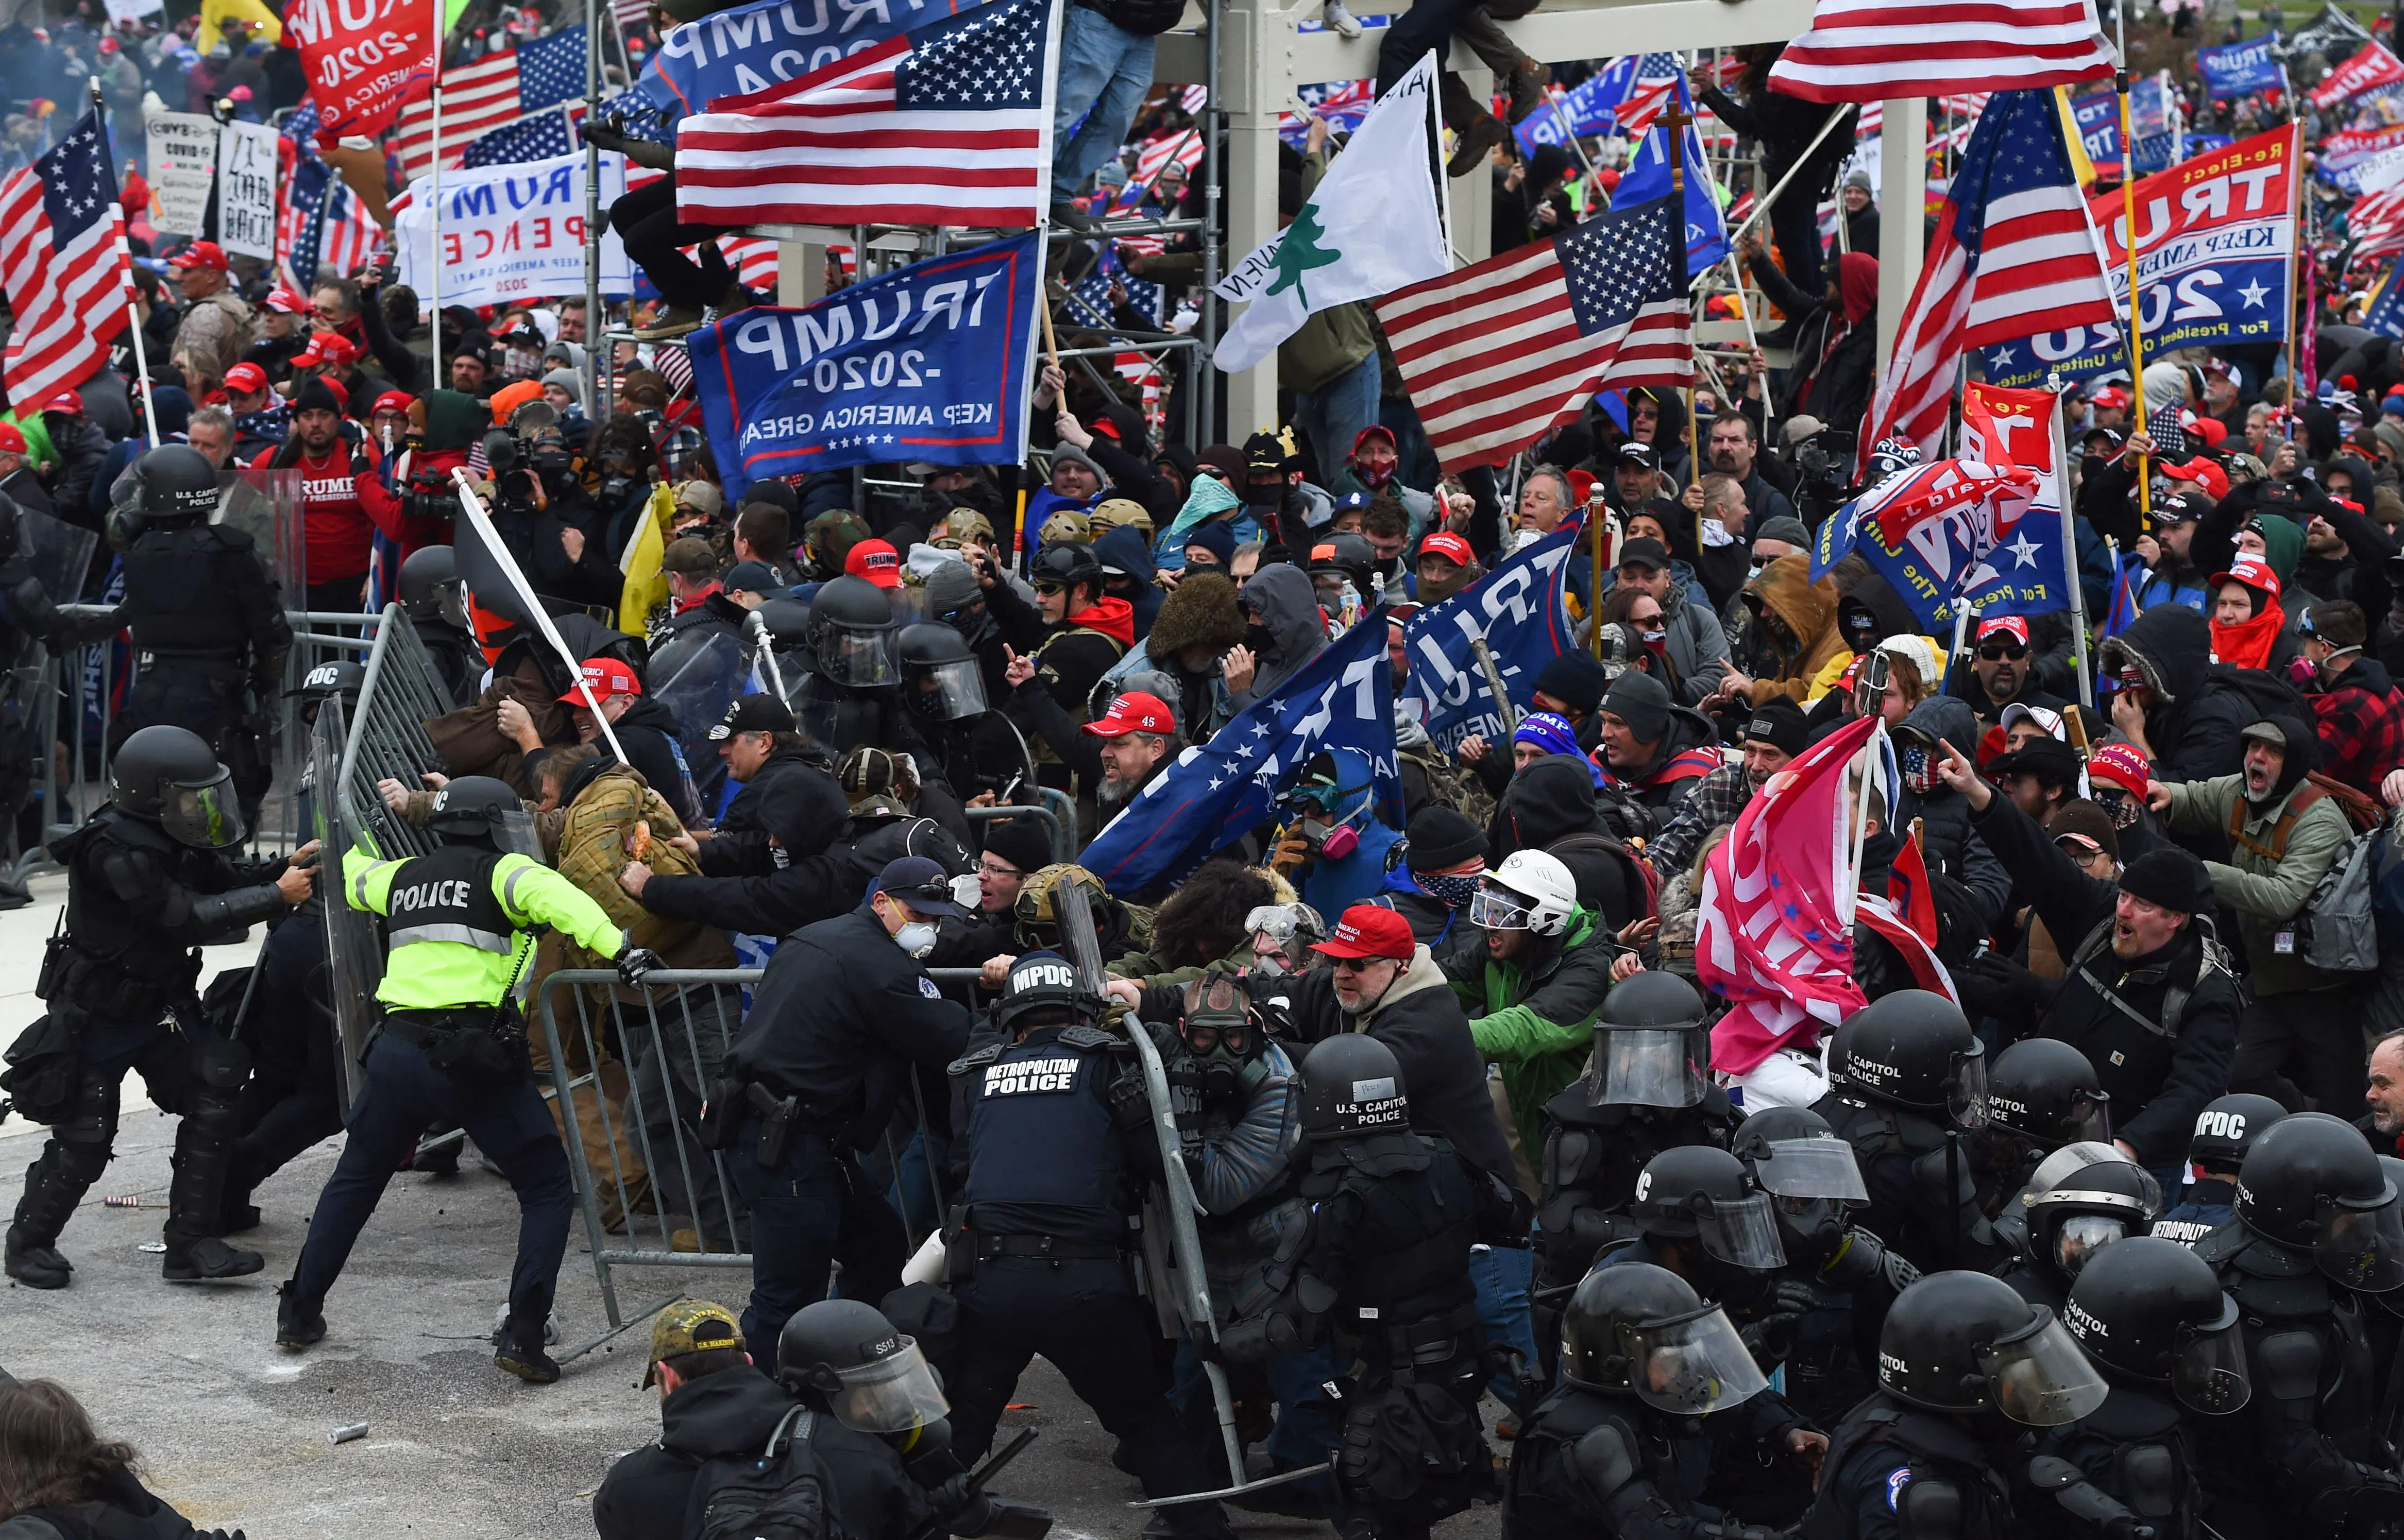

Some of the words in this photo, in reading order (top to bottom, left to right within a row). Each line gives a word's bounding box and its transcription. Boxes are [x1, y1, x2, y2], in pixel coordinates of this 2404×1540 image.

[302, 477, 354, 495] RUMP
[866, 555, 896, 566] TRUMP
[581, 667, 604, 676] MERICA
[1141, 715, 1155, 727] 45
[1526, 713, 1569, 730] UMP
[2091, 755, 2132, 775] 2020
[2104, 746, 2149, 771] RUMP
[392, 879, 471, 916] POLICE
[1013, 964, 1073, 995] MPDC
[985, 1058, 1079, 1080] METROPOLITAN
[1847, 1063, 1881, 1086] POLICE
[1854, 1055, 1902, 1078] CAPITOL
[984, 1073, 1072, 1097] POLICE
[1335, 1103, 1361, 1114] U.S.
[1365, 1095, 1407, 1113] CAPITOL
[1988, 1094, 2028, 1114] APITOL
[1358, 1109, 1400, 1125] POLICE
[1991, 1107, 2008, 1121] ICE
[2068, 1297, 2109, 1337] CAPITOL
[709, 1339, 735, 1348] MARINES
[875, 1338, 895, 1355] S513
